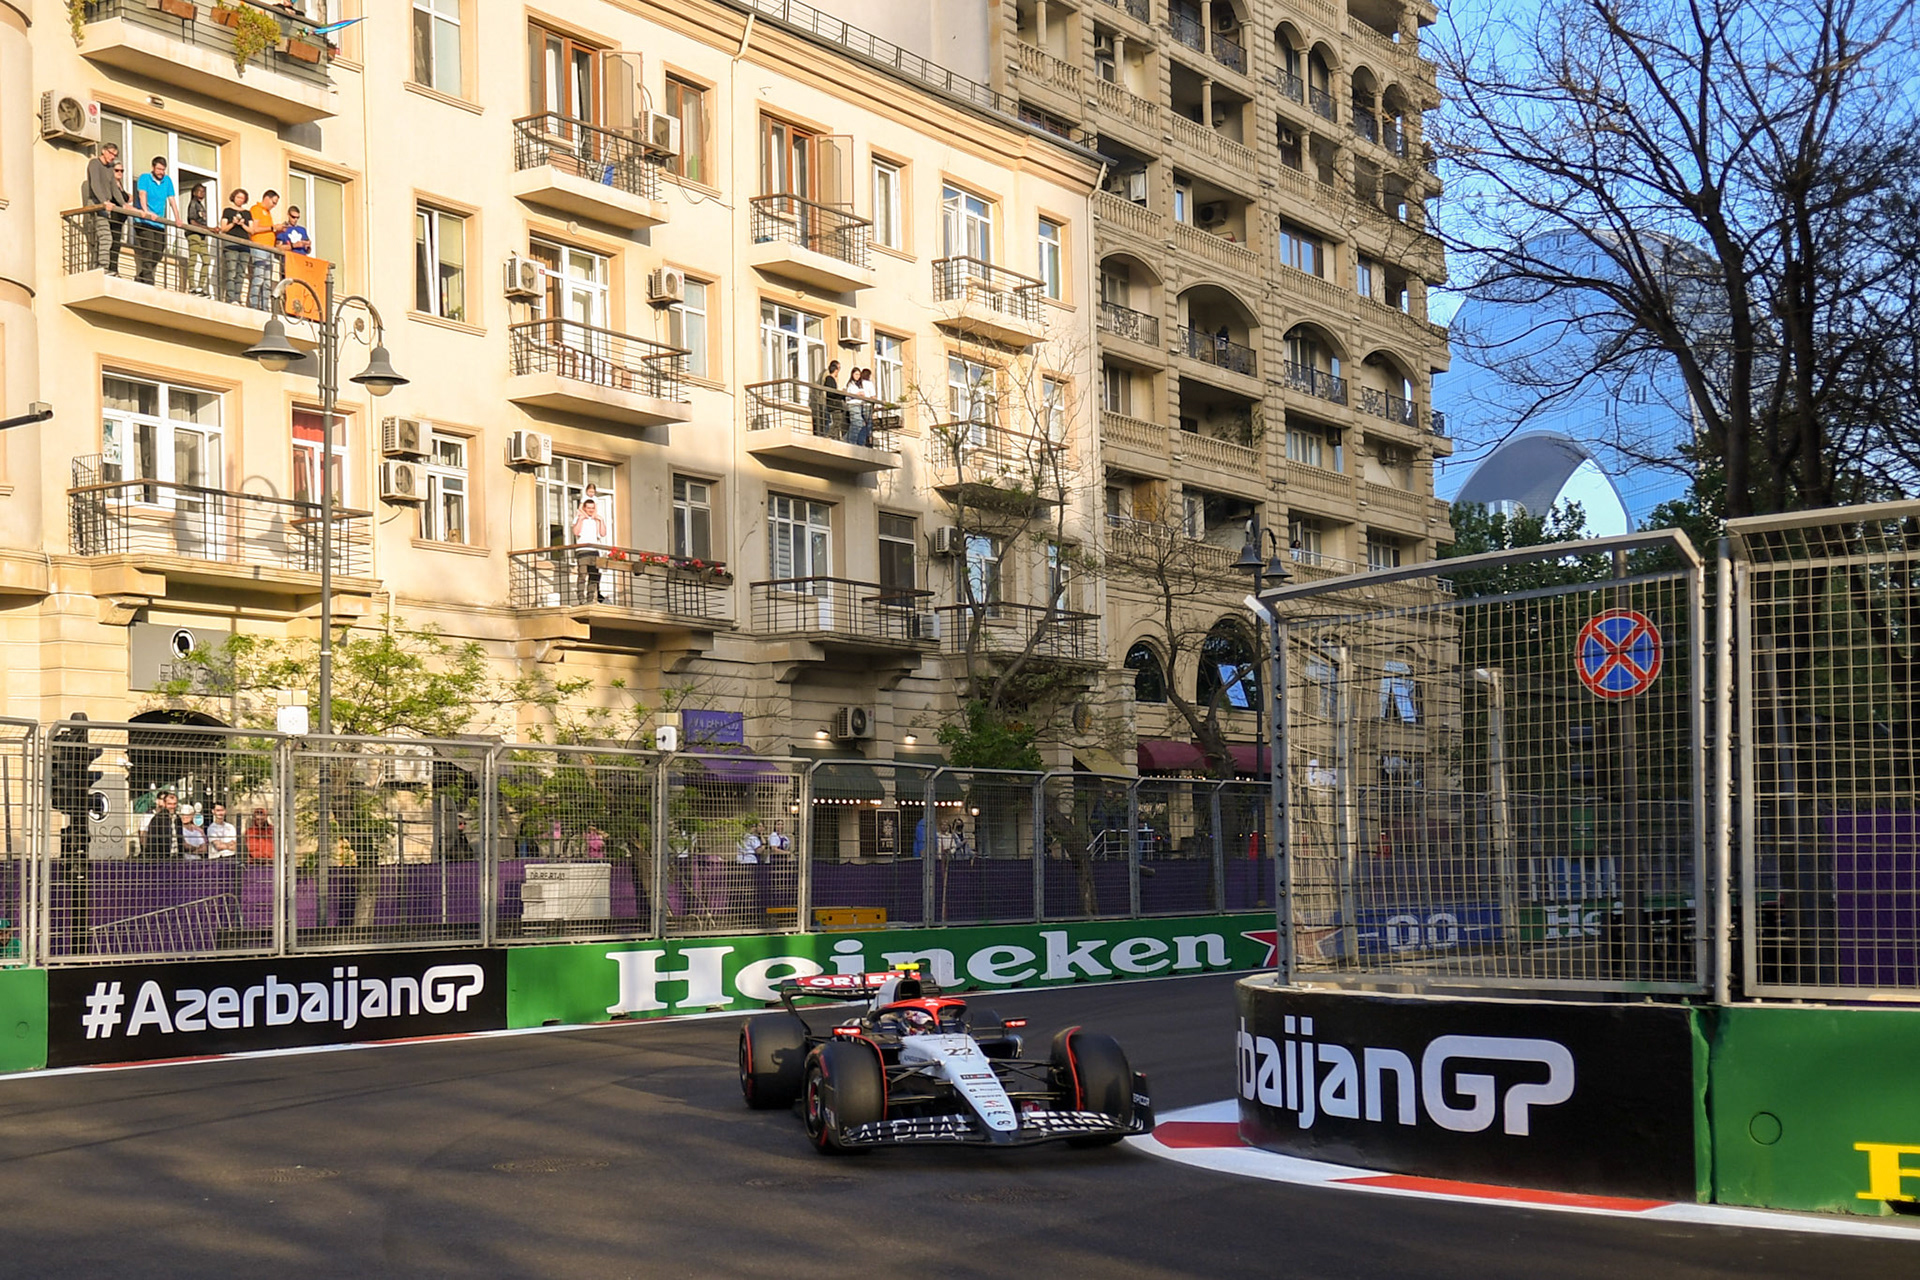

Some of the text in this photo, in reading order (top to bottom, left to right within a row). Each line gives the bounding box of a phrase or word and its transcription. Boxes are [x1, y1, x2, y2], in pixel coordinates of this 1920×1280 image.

[88, 825, 124, 844] NSO
[606, 929, 1233, 1015] Heineken
[82, 963, 486, 1039] #AzerbaijanGP
[943, 1047, 976, 1057] 22
